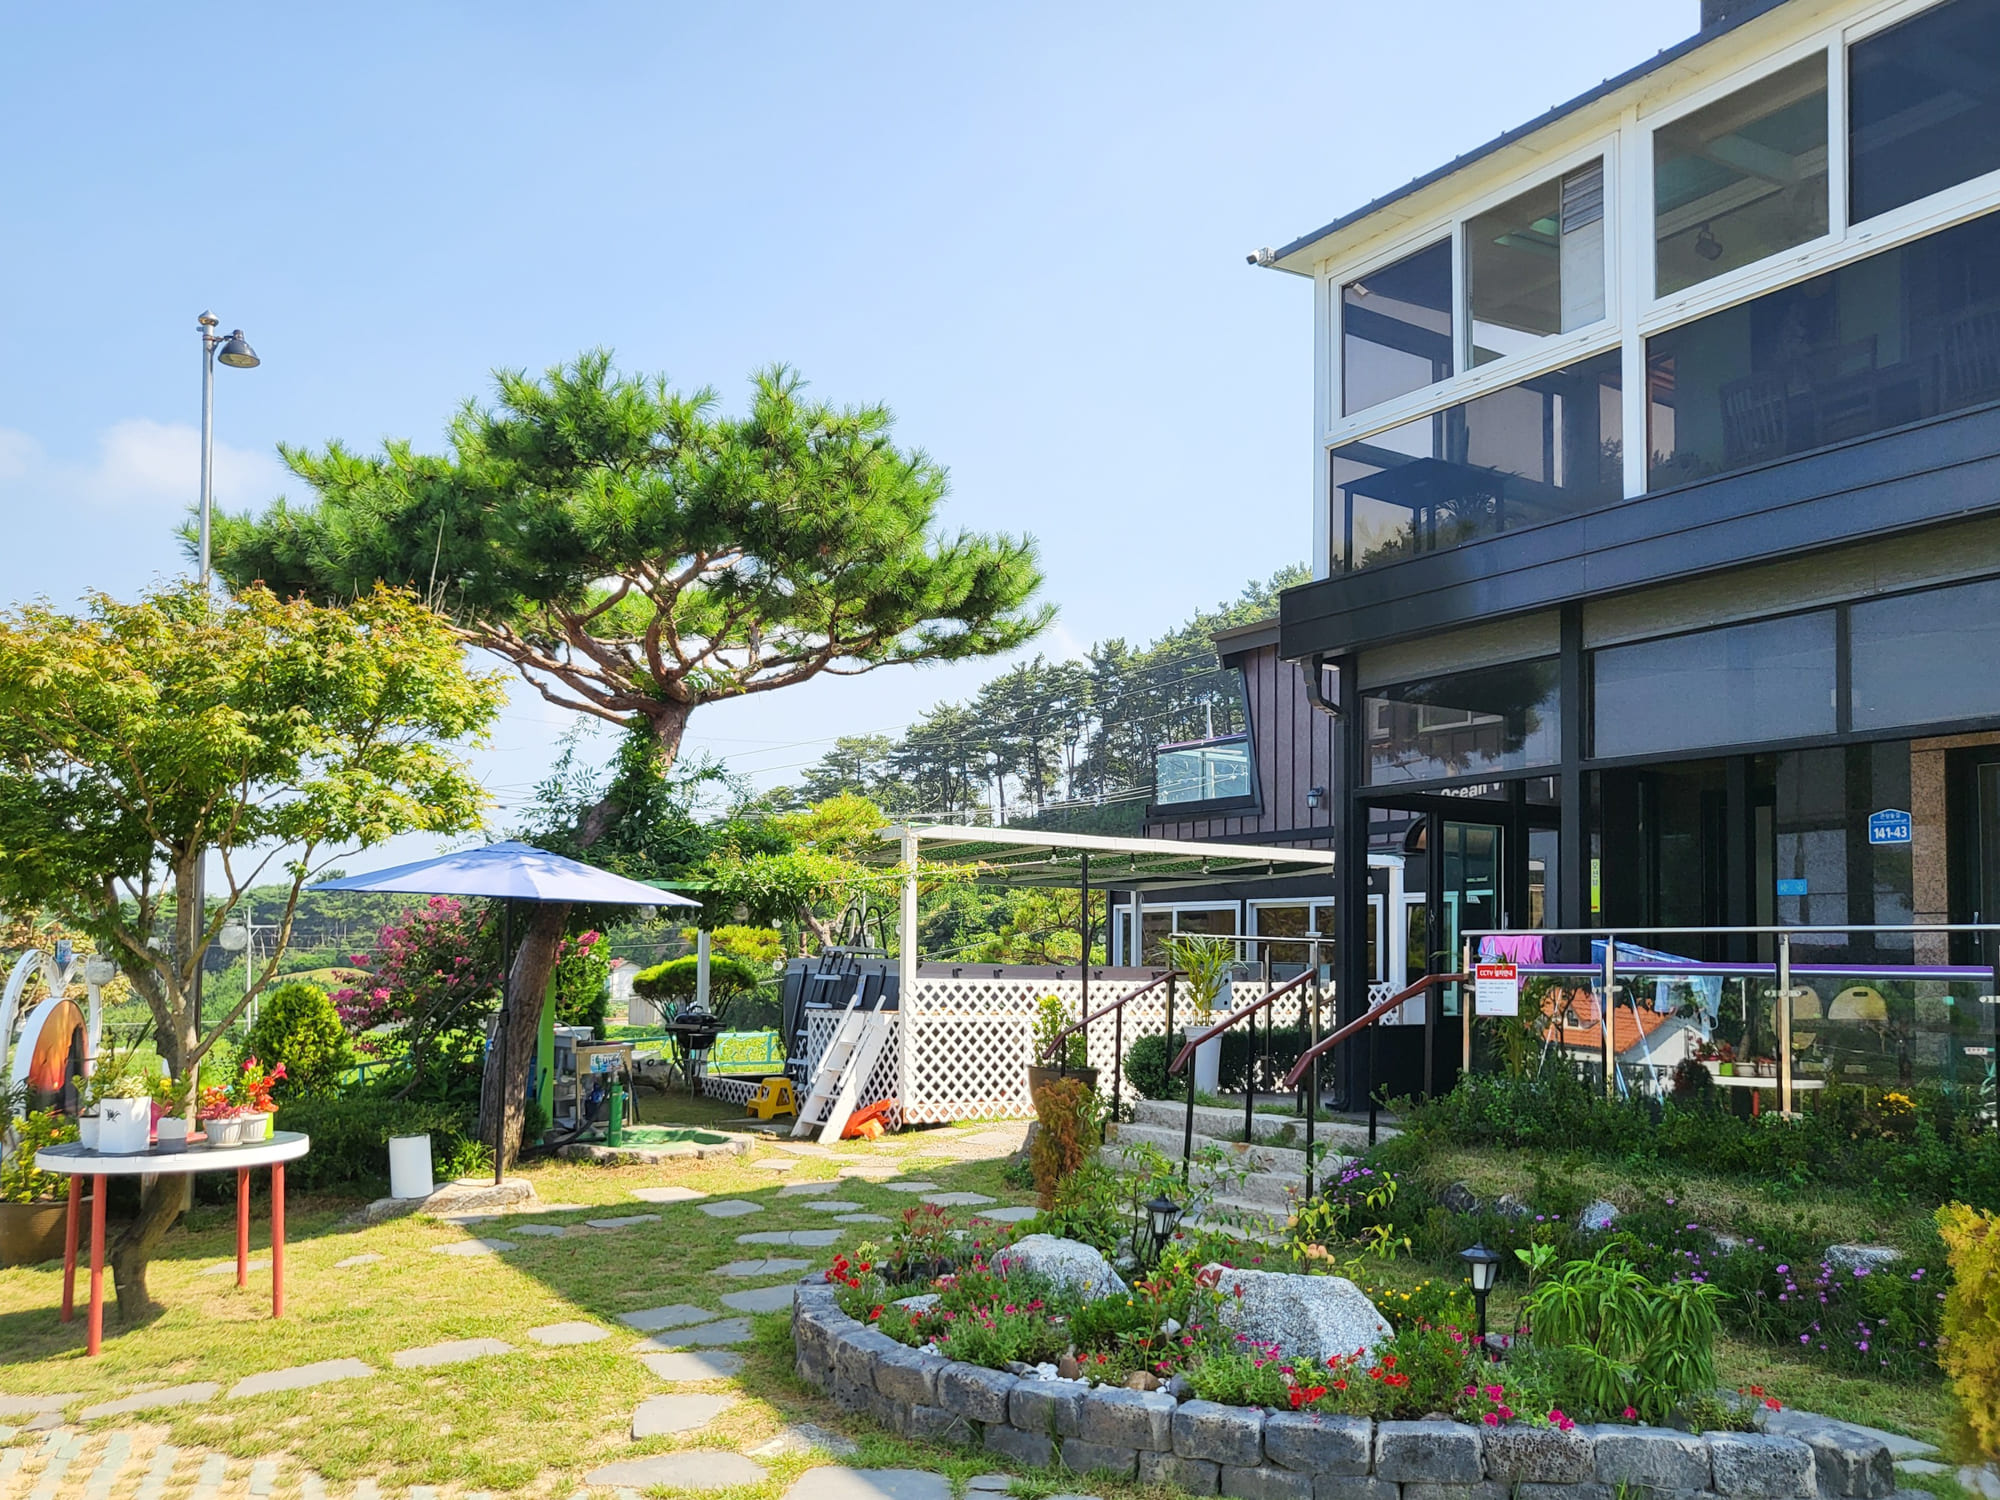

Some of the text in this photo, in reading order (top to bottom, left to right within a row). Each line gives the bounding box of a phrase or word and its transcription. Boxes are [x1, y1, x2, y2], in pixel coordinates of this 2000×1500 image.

[1441, 783, 1487, 798] Ocean
[1873, 826, 1907, 839] 141-43
[1479, 969, 1493, 977] CCTV
